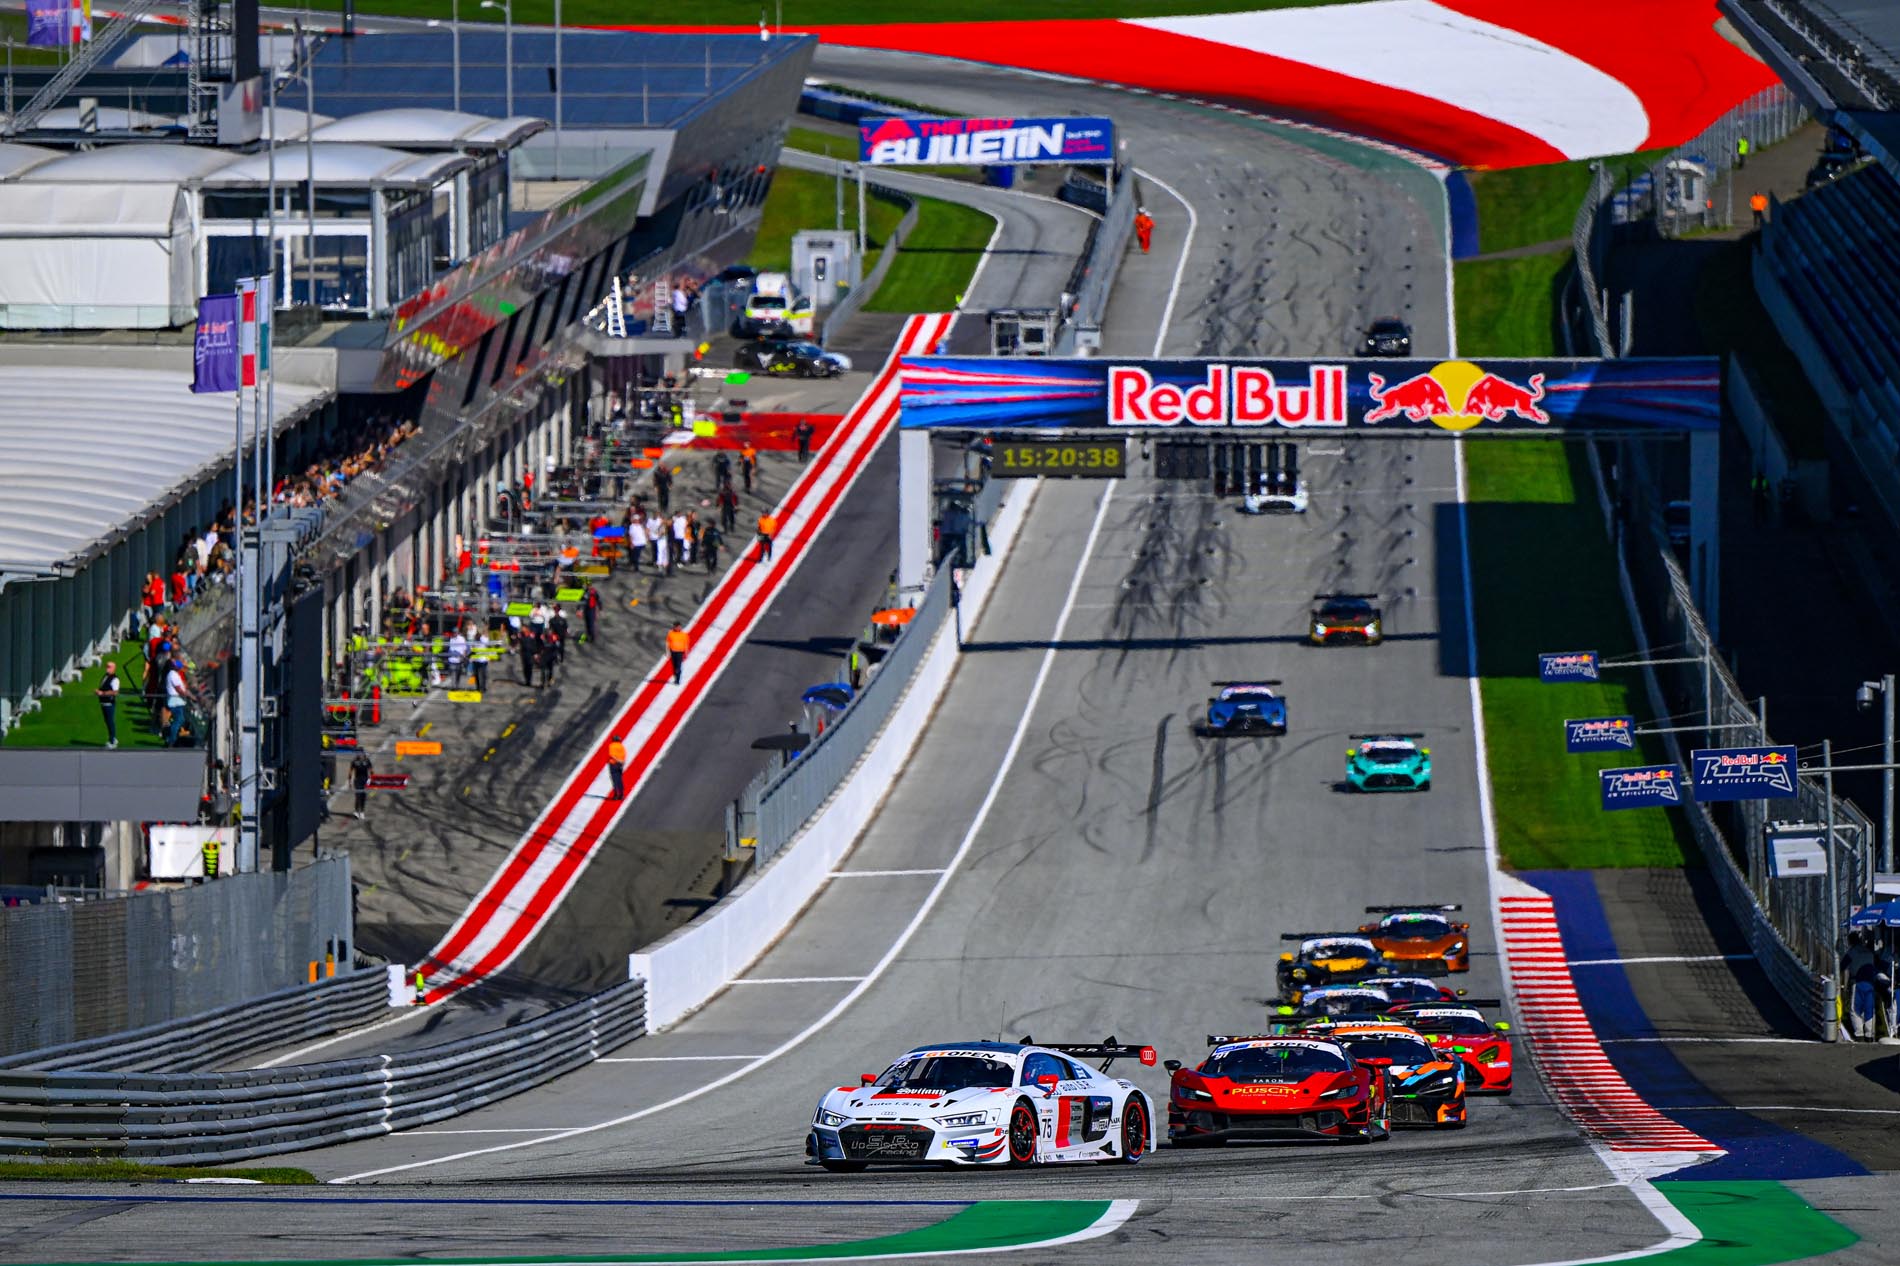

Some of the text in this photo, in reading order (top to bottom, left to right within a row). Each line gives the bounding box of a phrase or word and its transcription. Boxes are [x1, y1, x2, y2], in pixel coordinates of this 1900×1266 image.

[919, 121, 964, 136] THE
[1108, 364, 1348, 427] Red Bull
[1003, 448, 1120, 467] 15:20:38
[947, 1050, 996, 1059] OPEN
[1231, 1087, 1300, 1095] PLUSCITY
[1041, 1118, 1052, 1139] 75
